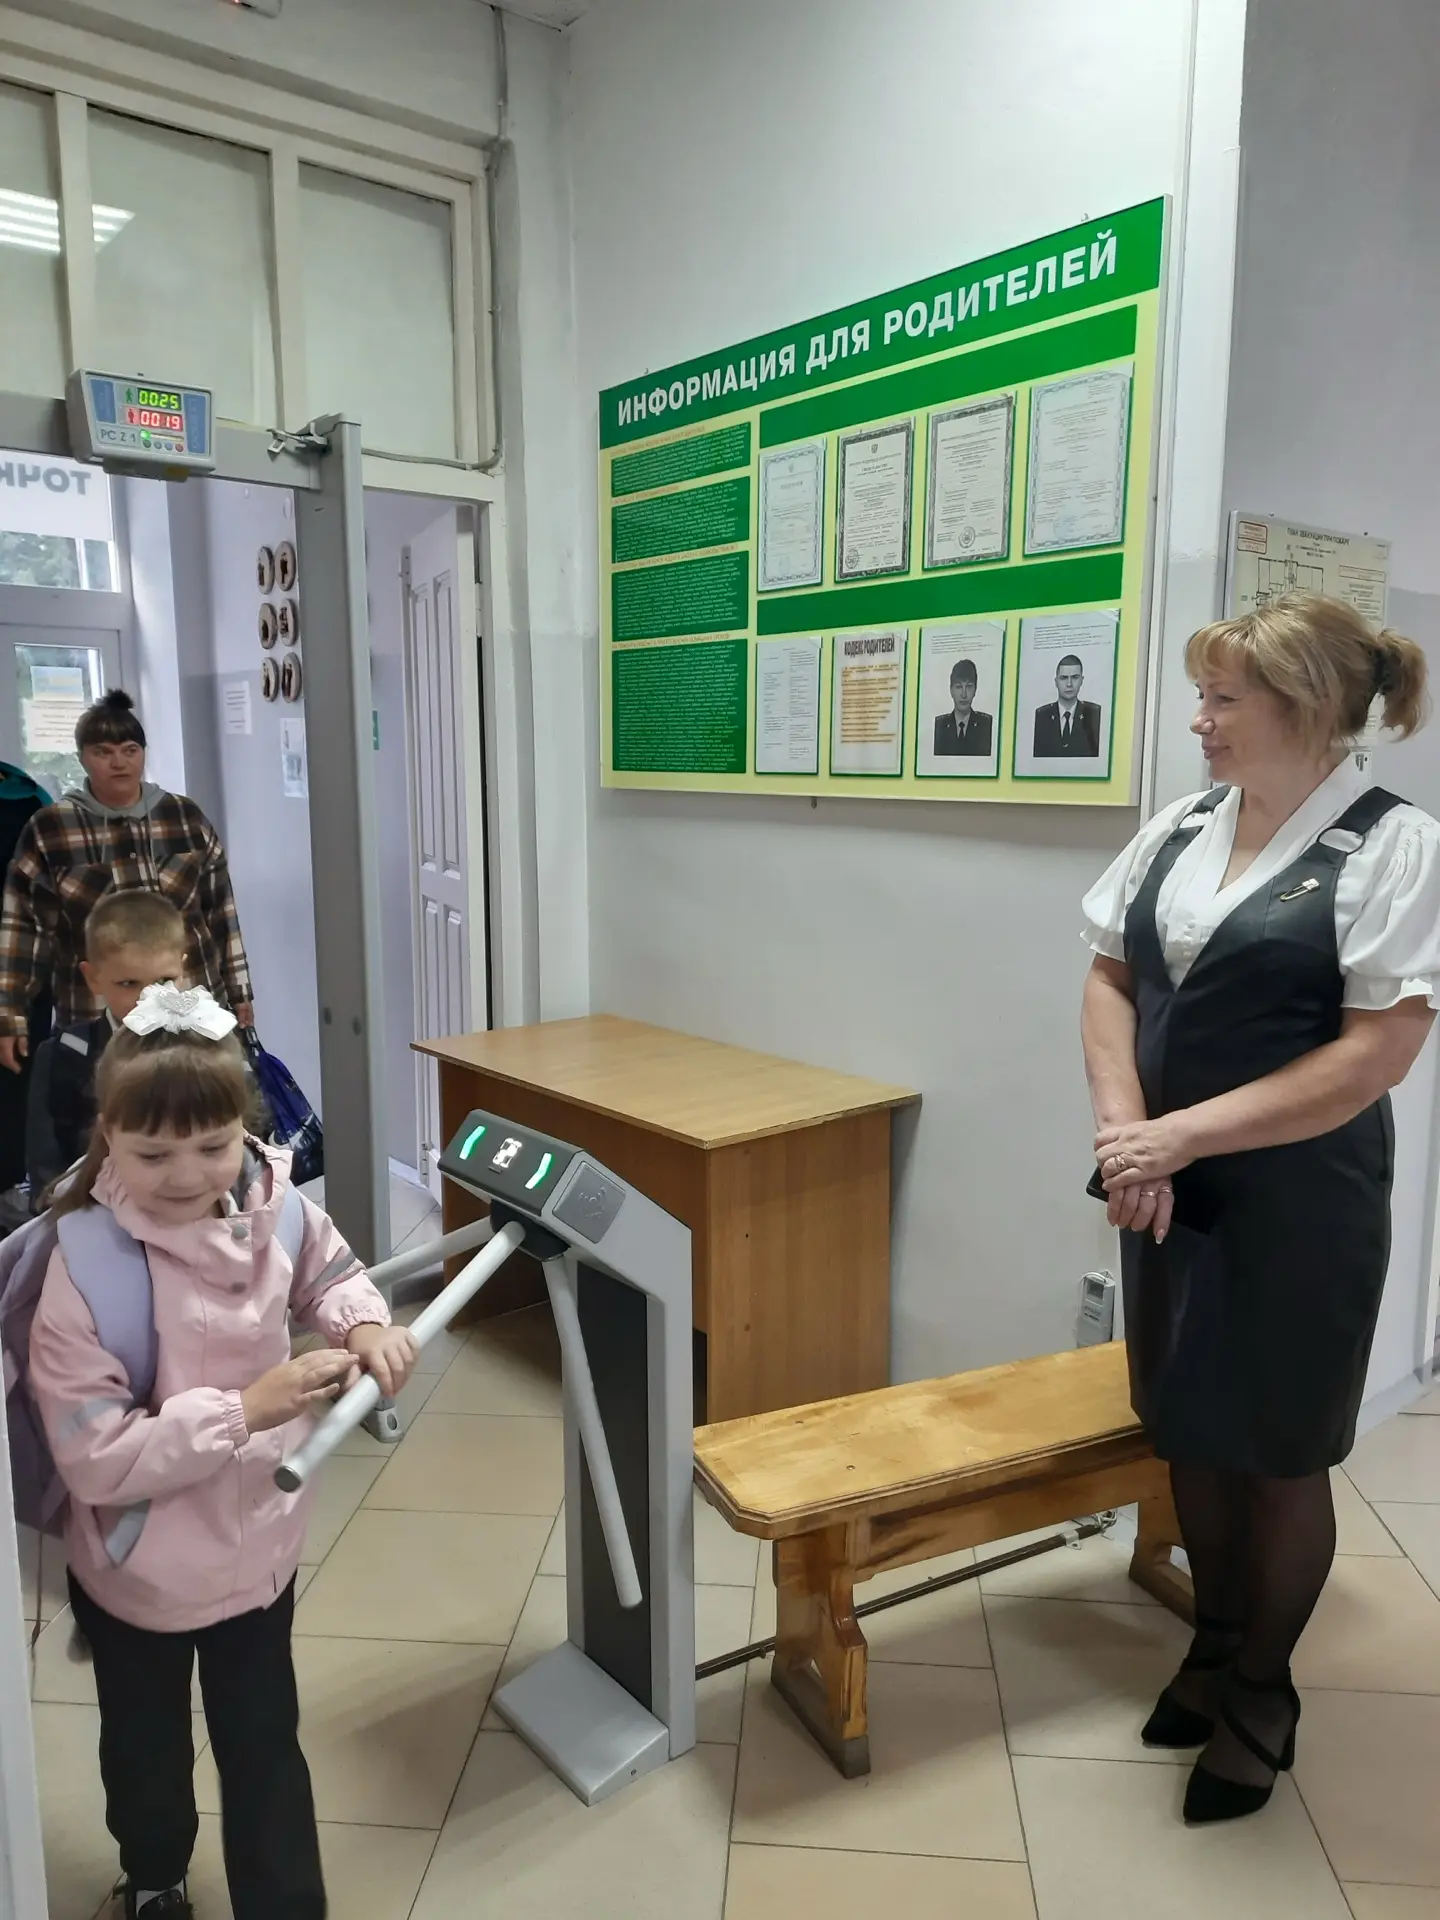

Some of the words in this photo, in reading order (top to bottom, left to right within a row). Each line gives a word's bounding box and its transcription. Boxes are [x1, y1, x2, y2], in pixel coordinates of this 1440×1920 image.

[617, 343, 796, 426] ИНФОРМАЦИЯ
[805, 320, 870, 374] ДЛЯ
[883, 228, 1117, 345] РОДИТЕЛЕЙ
[139, 390, 179, 409] 0025
[140, 411, 180, 429] 0019
[864, 634, 895, 656] РОДИТЕЛЕЙ
